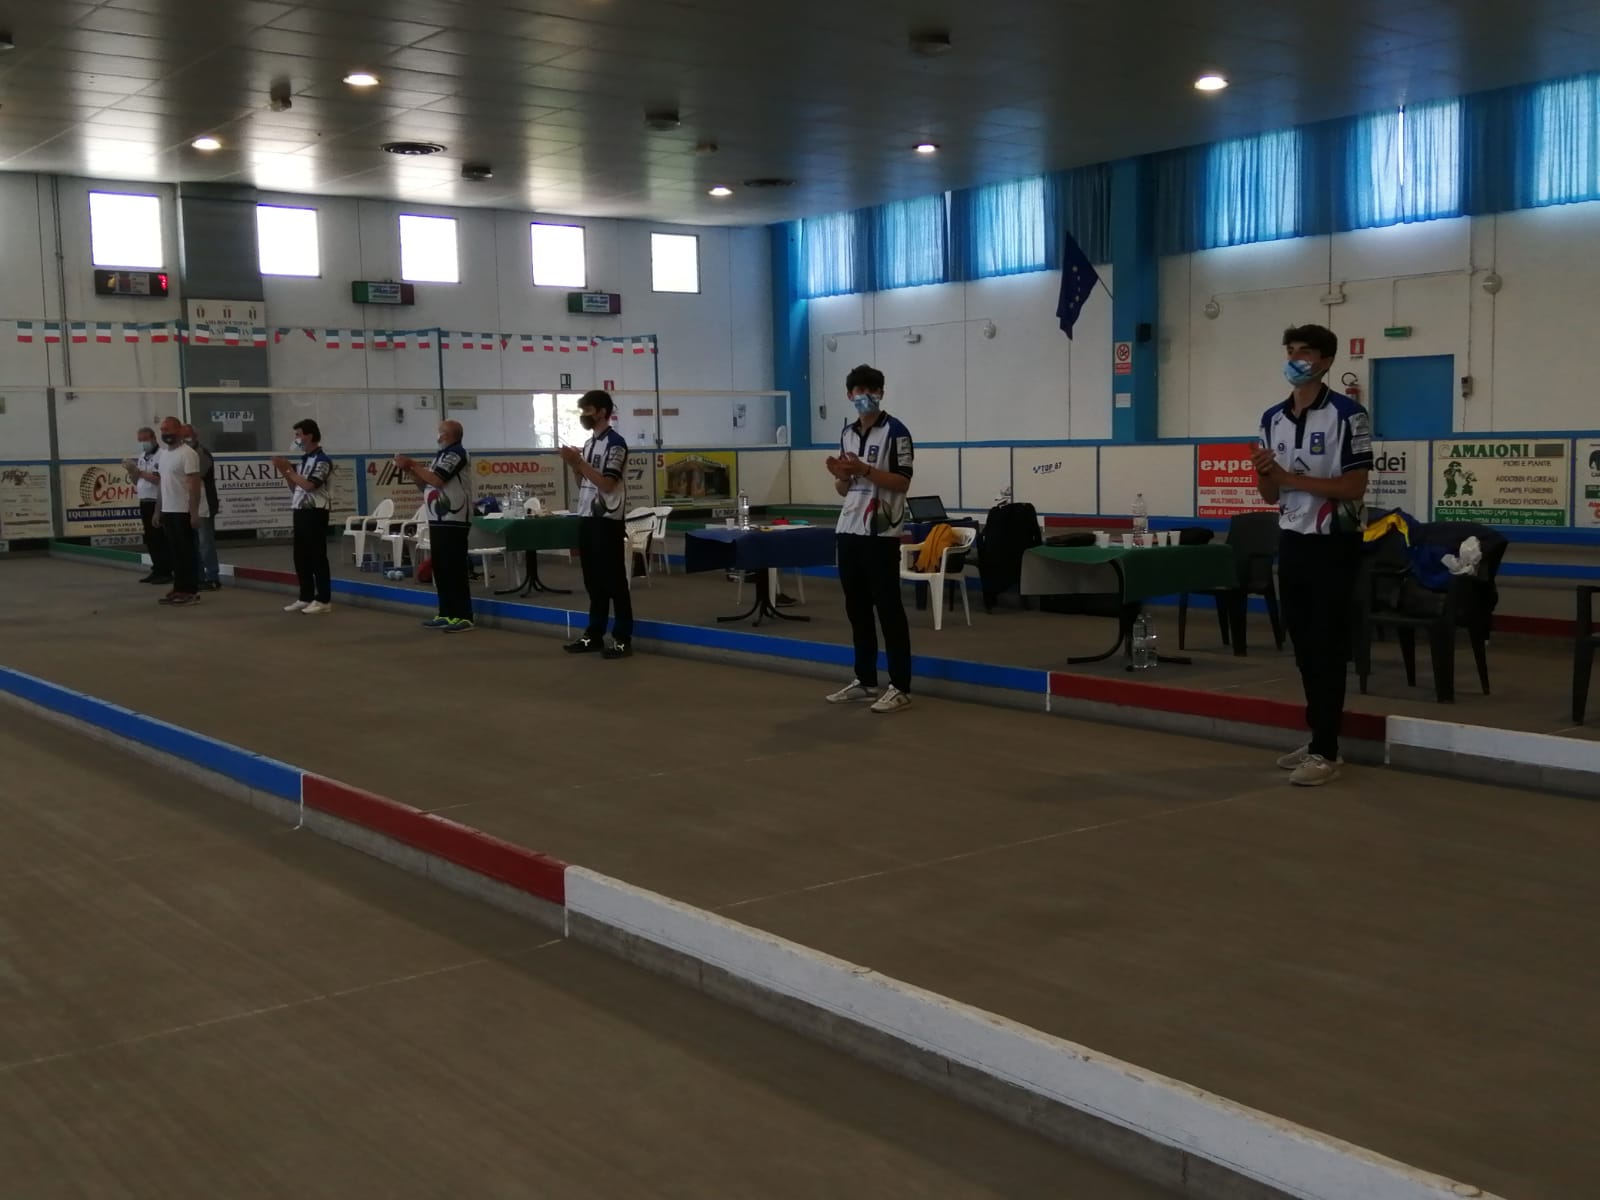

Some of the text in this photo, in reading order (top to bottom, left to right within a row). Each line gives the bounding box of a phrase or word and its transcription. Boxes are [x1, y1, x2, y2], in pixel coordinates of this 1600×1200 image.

[491, 462, 540, 474] CONAD
[657, 456, 665, 468] 5
[367, 462, 377, 476] 4
[222, 479, 285, 490] assicurazioni
[1215, 474, 1253, 484] marozzi
